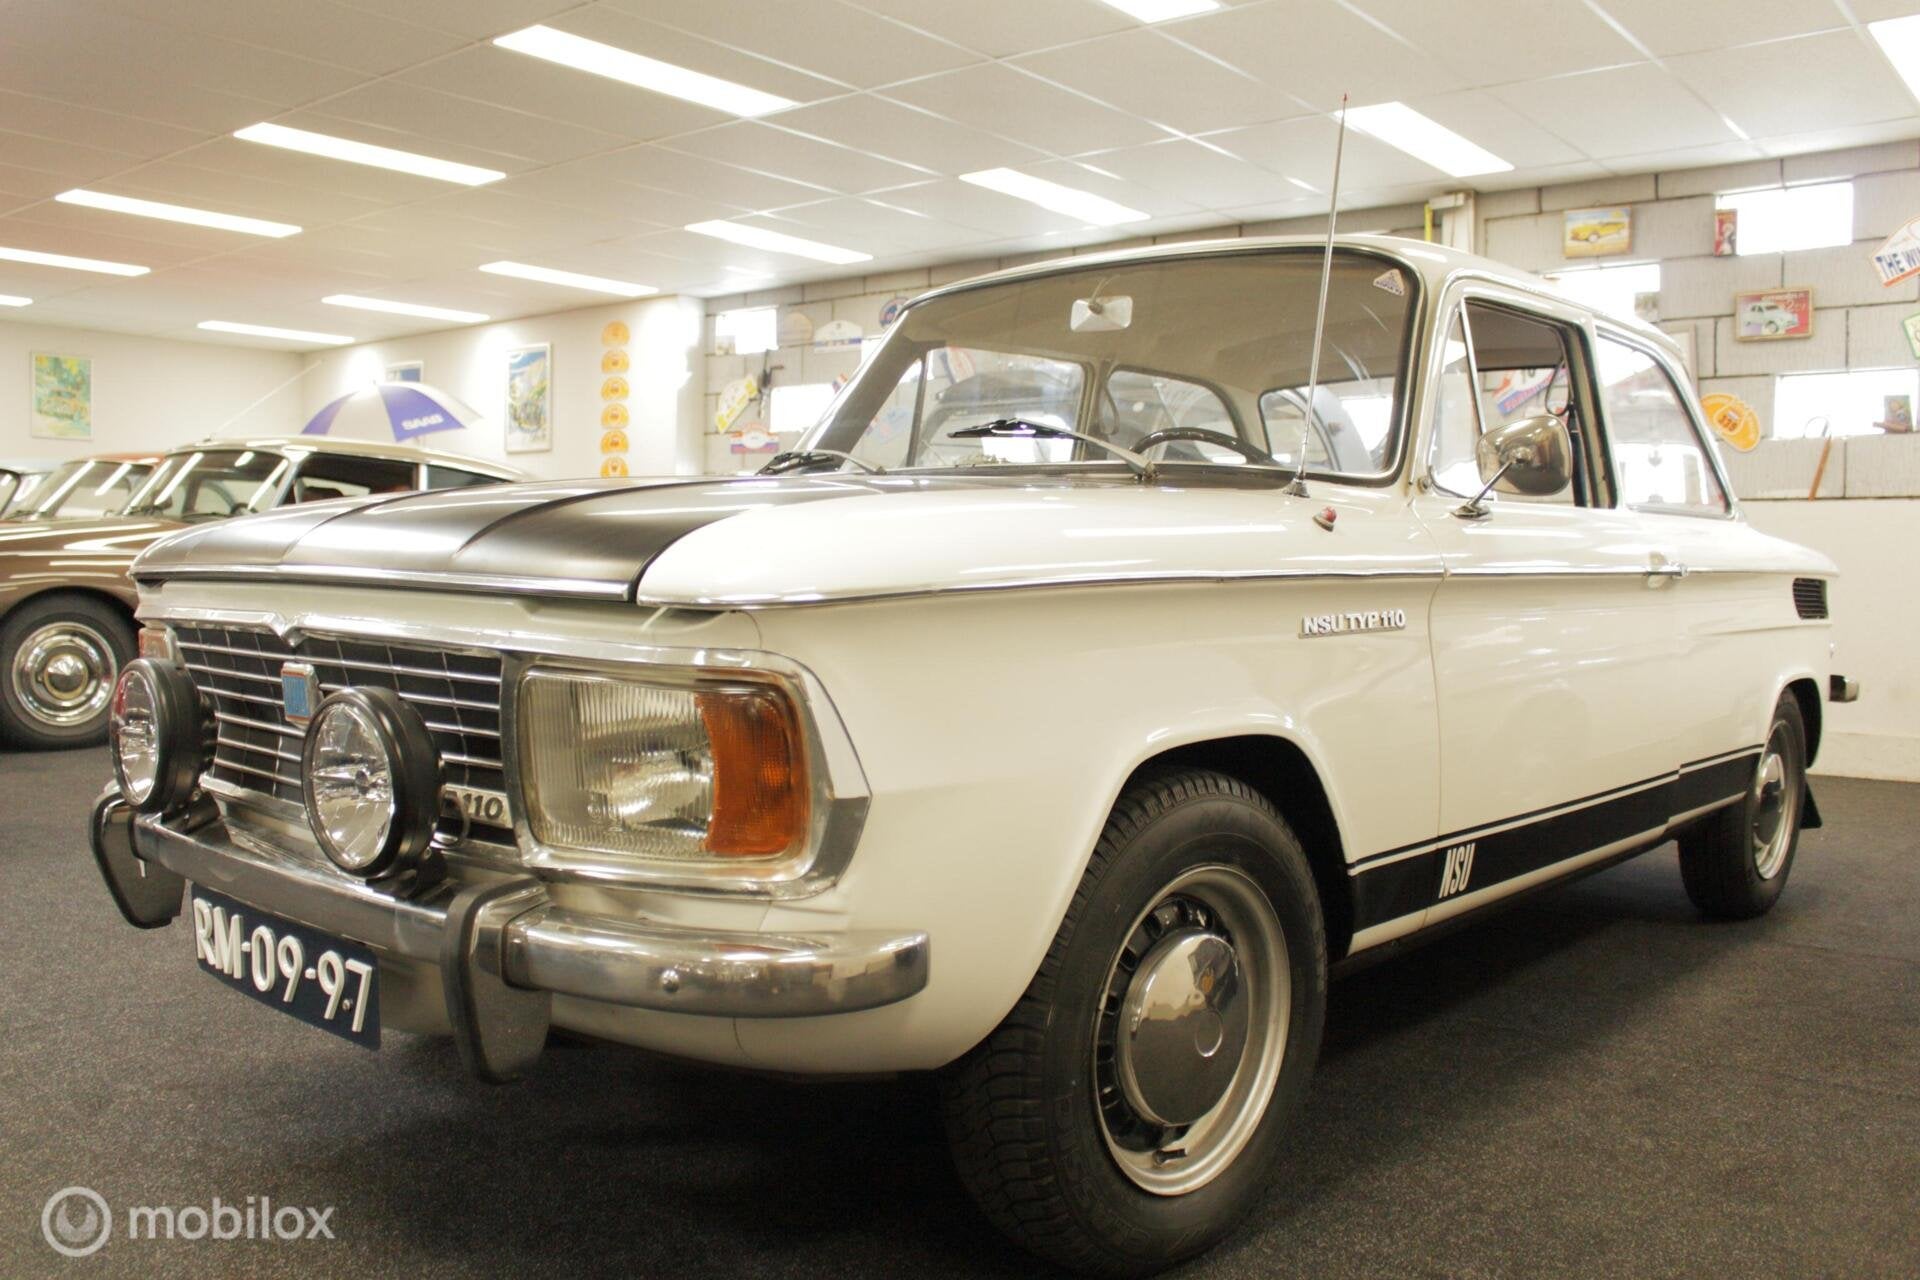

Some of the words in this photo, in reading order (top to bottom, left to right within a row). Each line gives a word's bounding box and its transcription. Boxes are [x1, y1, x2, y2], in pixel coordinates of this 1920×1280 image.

[402, 413, 444, 430] SAAB
[1302, 613, 1345, 635] NSU
[1346, 611, 1379, 629] TYP
[1380, 608, 1406, 628] 110
[462, 792, 504, 820] 110
[1438, 842, 1476, 899] NSU
